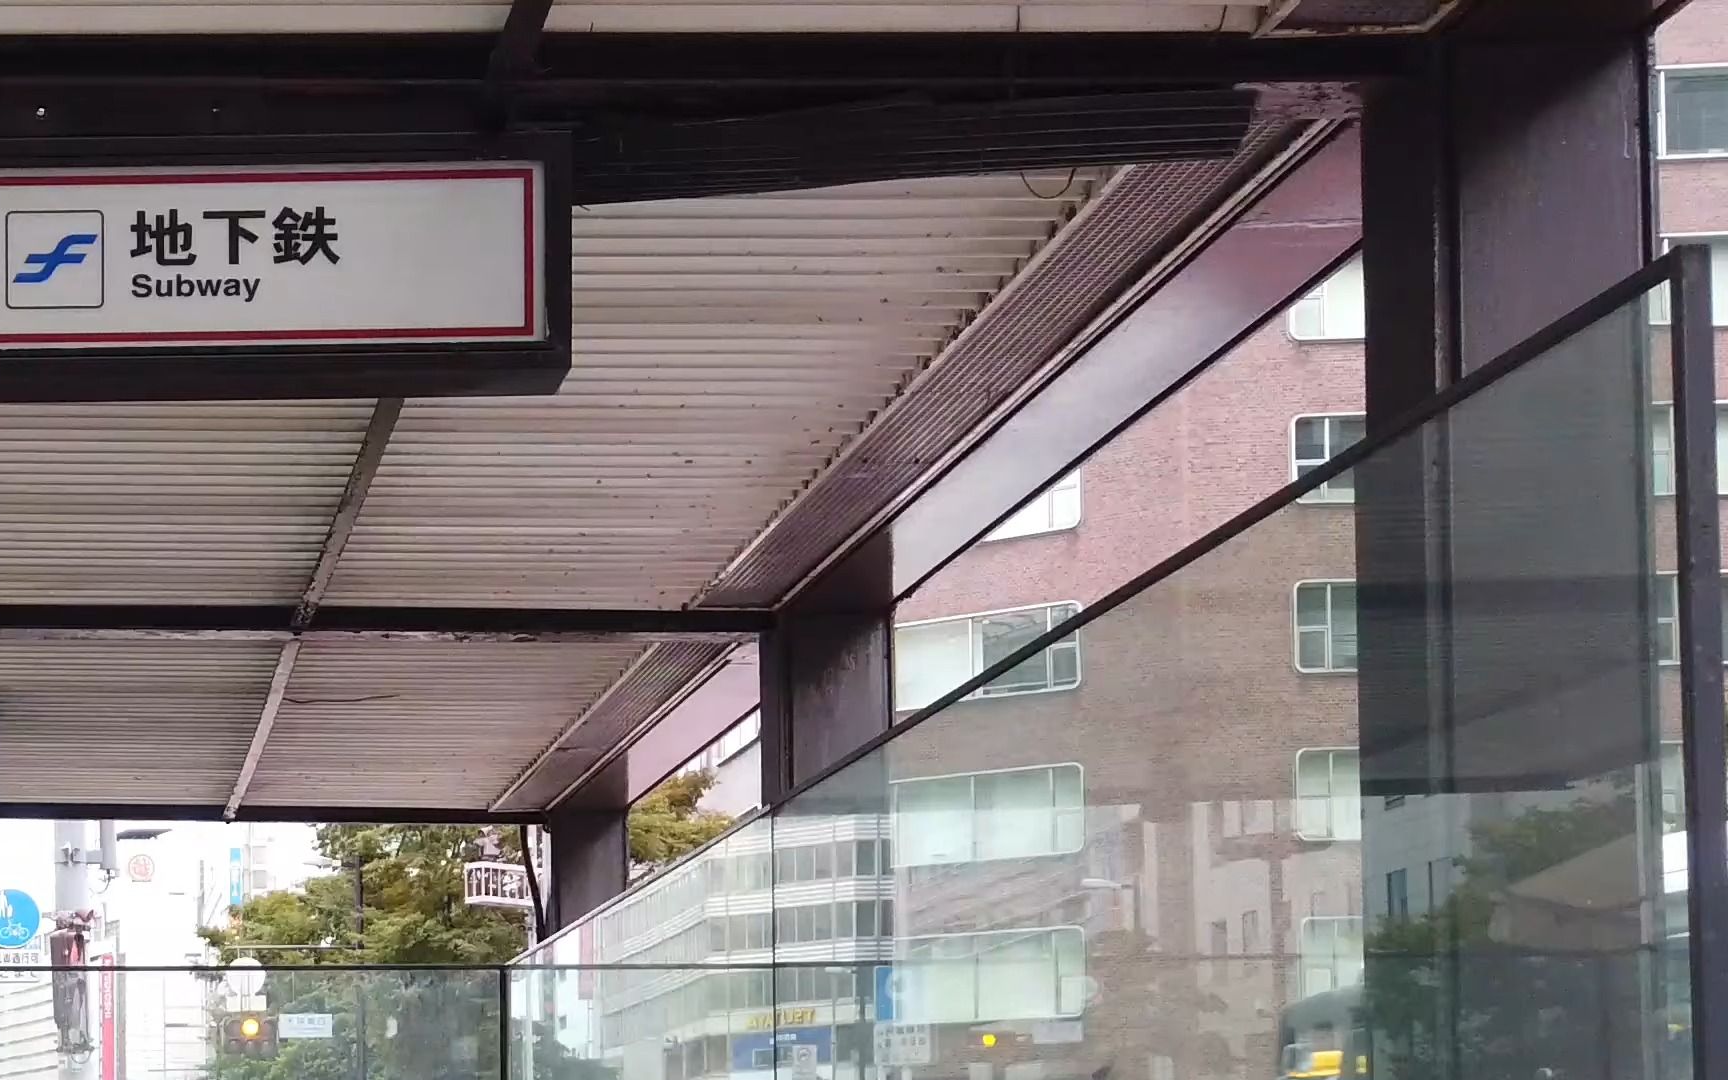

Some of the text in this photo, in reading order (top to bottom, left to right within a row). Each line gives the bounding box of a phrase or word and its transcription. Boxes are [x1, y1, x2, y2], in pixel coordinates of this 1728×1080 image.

[129, 205, 341, 267] 地下鉄
[131, 273, 261, 303] Subway
